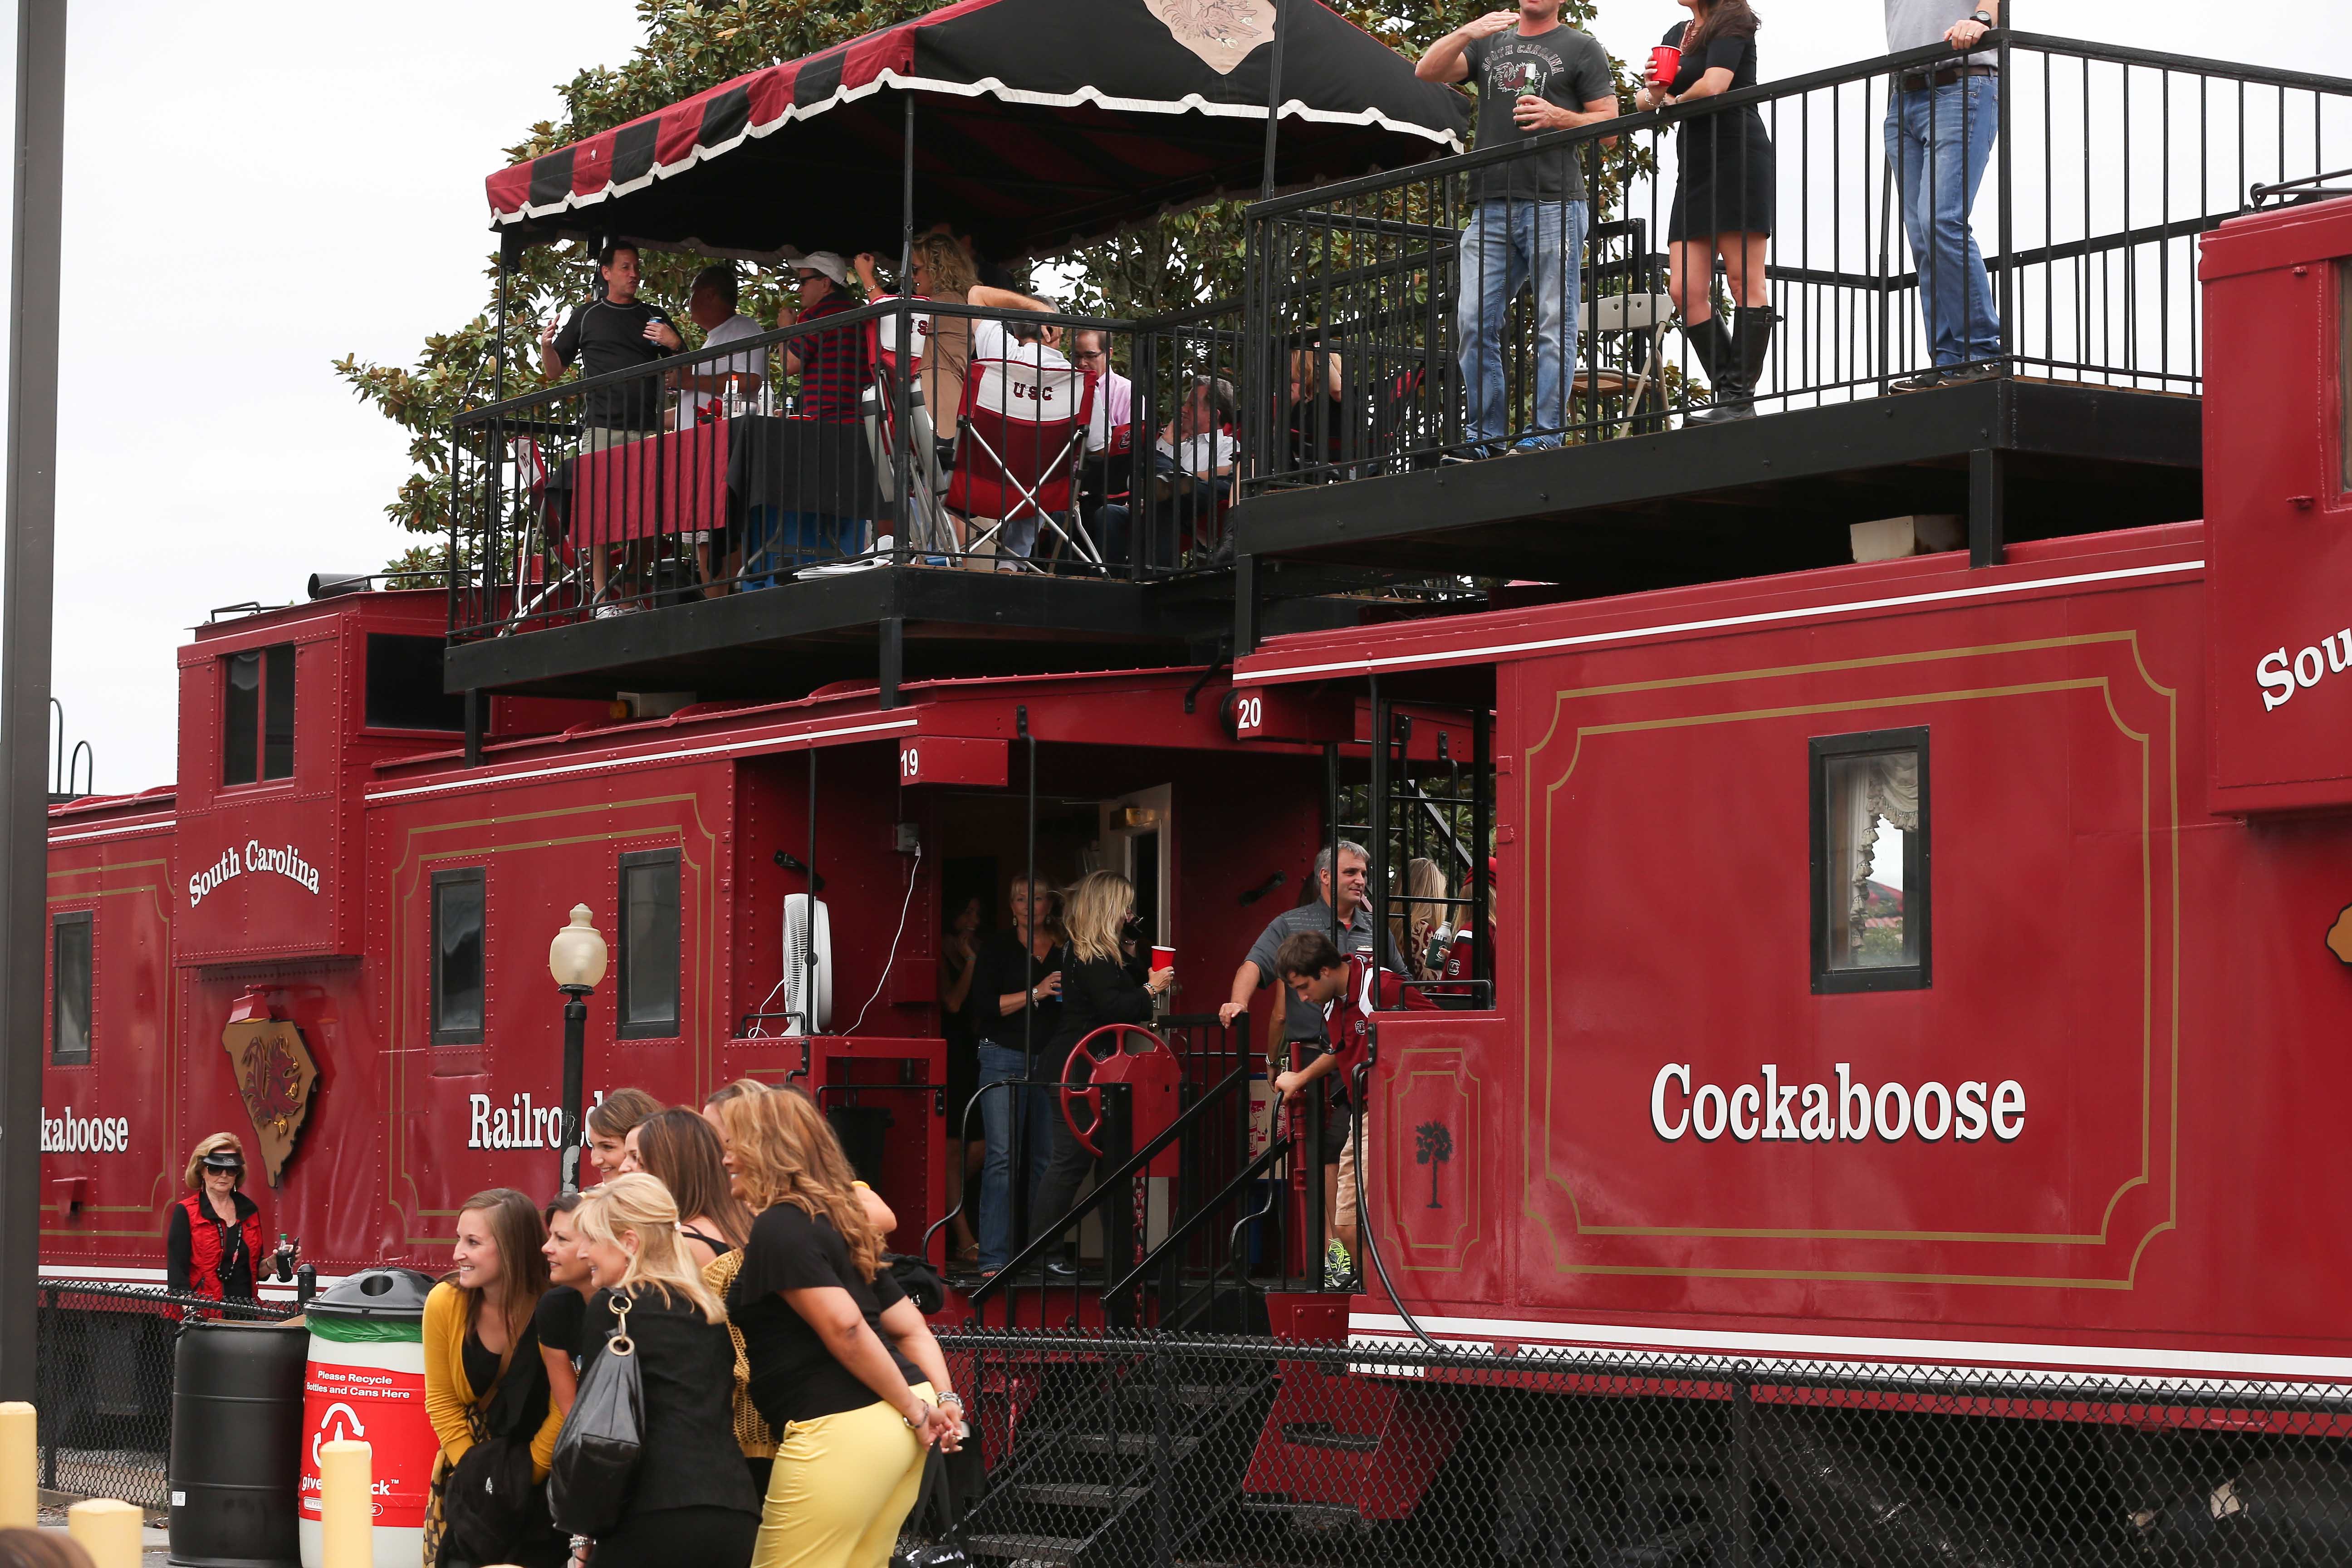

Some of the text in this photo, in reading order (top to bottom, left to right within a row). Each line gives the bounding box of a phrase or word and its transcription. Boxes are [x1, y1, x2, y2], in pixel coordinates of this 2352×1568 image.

[1014, 382, 1053, 401] USC
[1238, 697, 1261, 729] 20
[900, 748, 918, 777] 19
[189, 840, 319, 908] South Carolina
[1651, 1062, 2026, 1141] Cockaboose
[468, 1090, 603, 1150] Railrod
[306, 1382, 410, 1398] Bottles and Cans Here
[318, 1370, 392, 1385] Please Recycle
